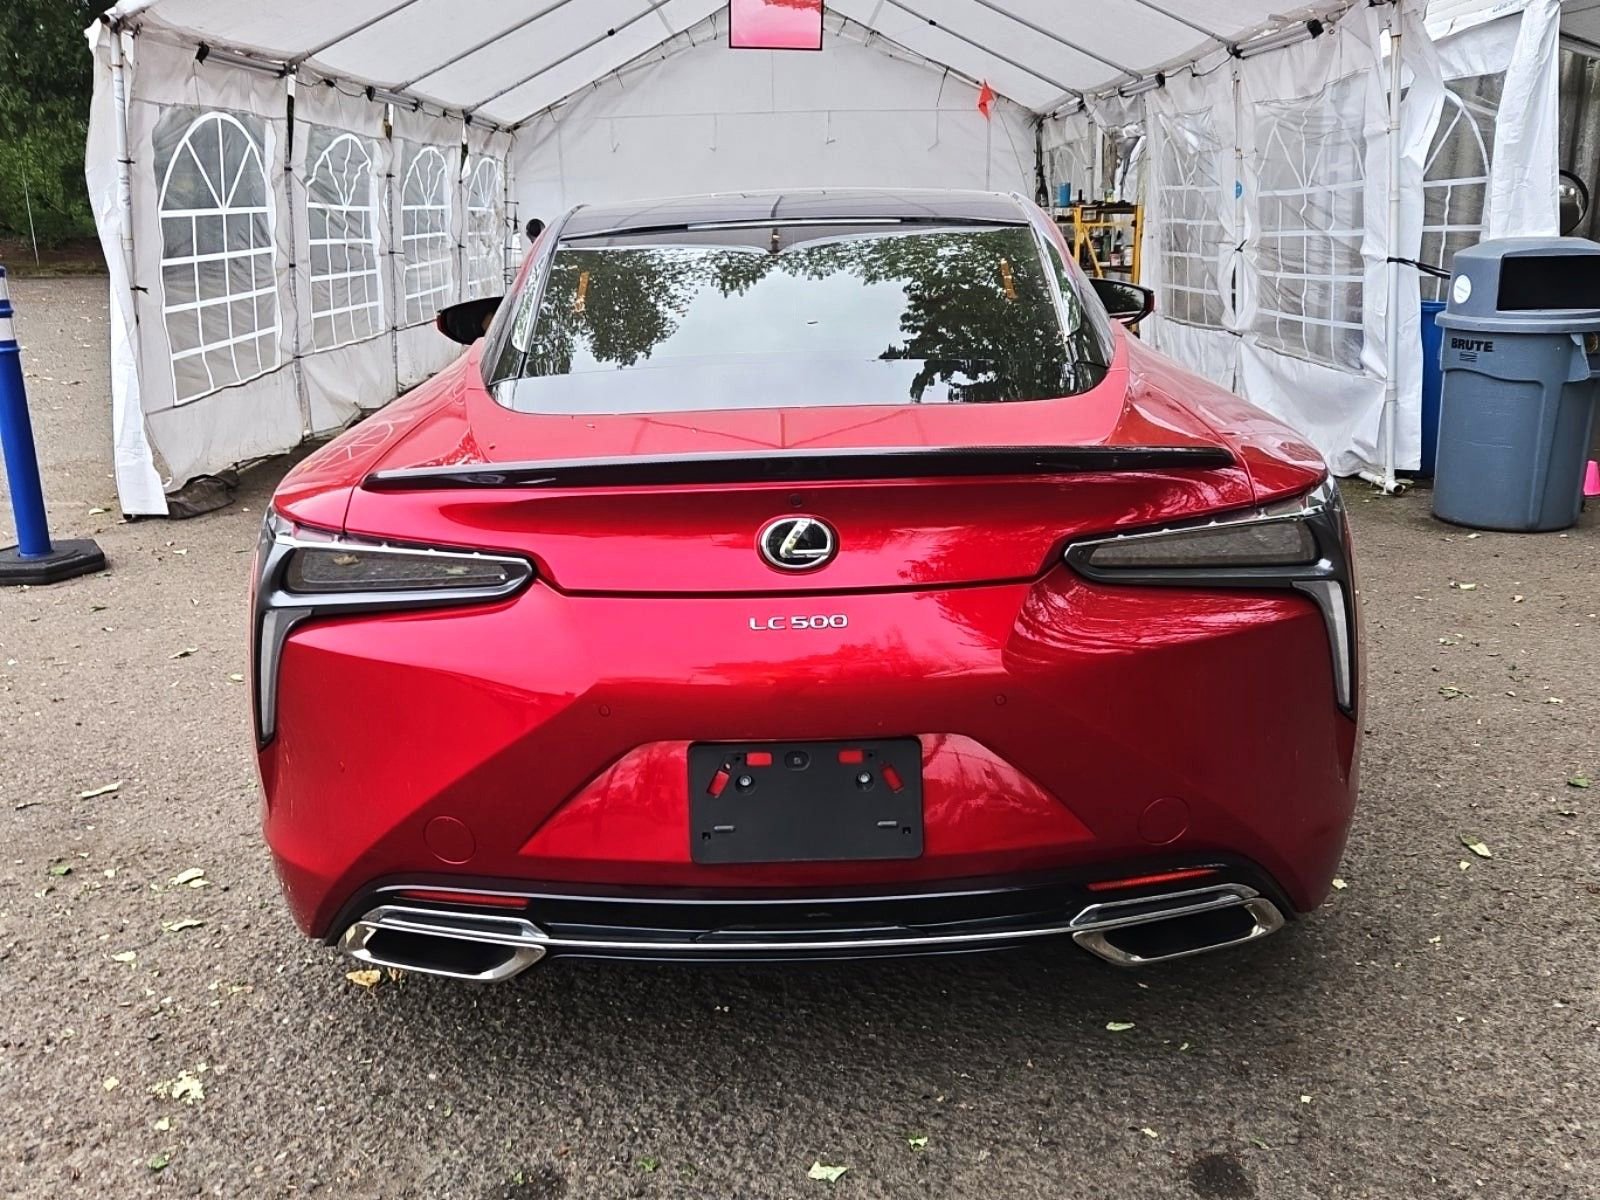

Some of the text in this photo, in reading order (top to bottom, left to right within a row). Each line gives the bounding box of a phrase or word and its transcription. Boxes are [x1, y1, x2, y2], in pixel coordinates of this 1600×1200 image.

[1451, 337, 1494, 352] BRUTE
[749, 614, 848, 630] LC 500
